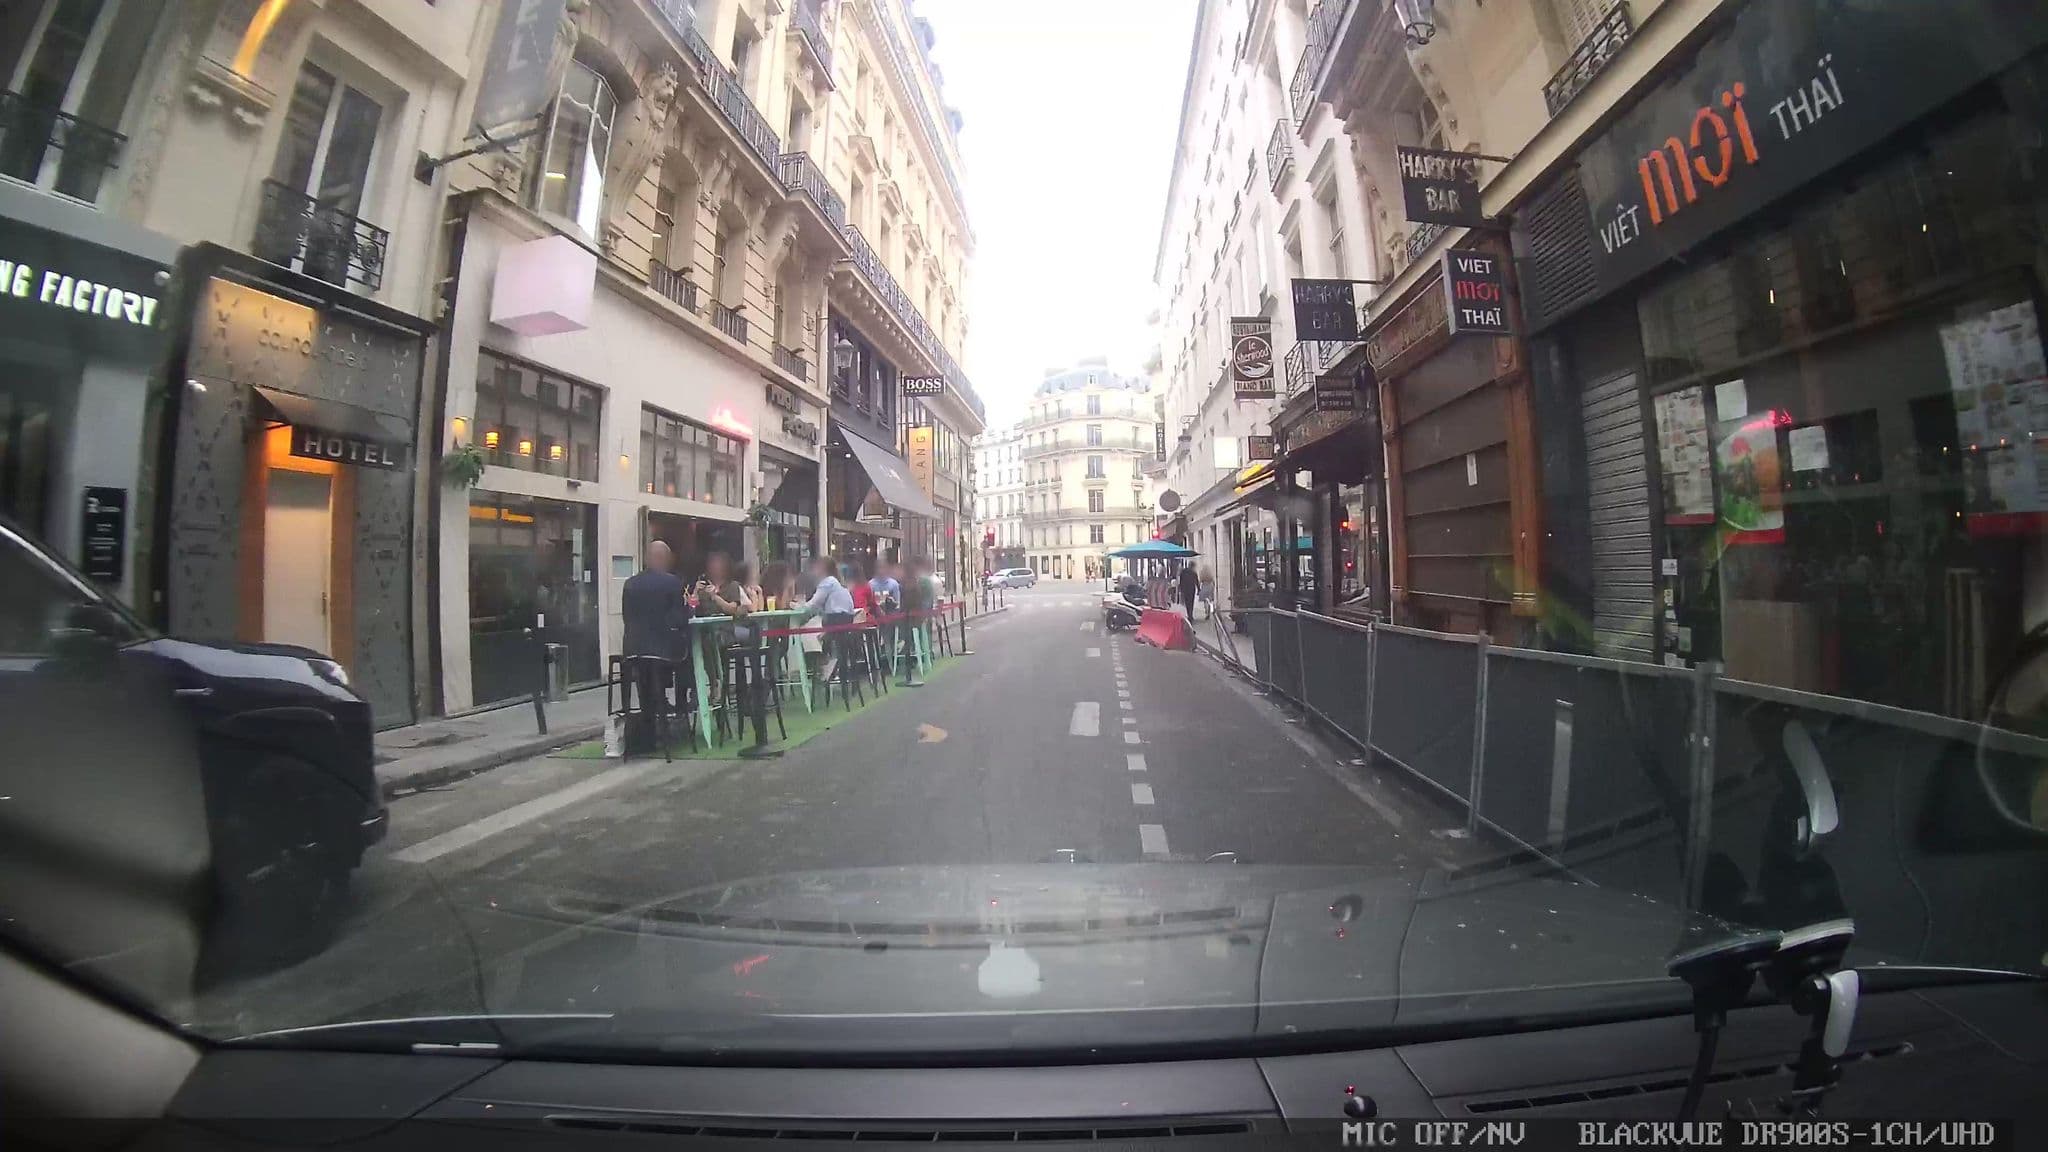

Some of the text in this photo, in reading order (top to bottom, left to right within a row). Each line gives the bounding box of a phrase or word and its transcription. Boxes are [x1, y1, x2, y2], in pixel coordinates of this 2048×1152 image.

[1600, 203, 1640, 253] VIÊT
[1768, 53, 1845, 140] THAÏ
[1400, 151, 1475, 184] HARRY'S
[1425, 186, 1462, 213] BAR
[1457, 257, 1493, 274] VIET
[40, 270, 159, 327] FACTORY
[1294, 284, 1354, 306] HARRY'S
[1311, 311, 1342, 329] BAR
[1461, 307, 1501, 326] THAÏ
[906, 378, 942, 390] BOSS
[303, 431, 394, 466] HOTEL
